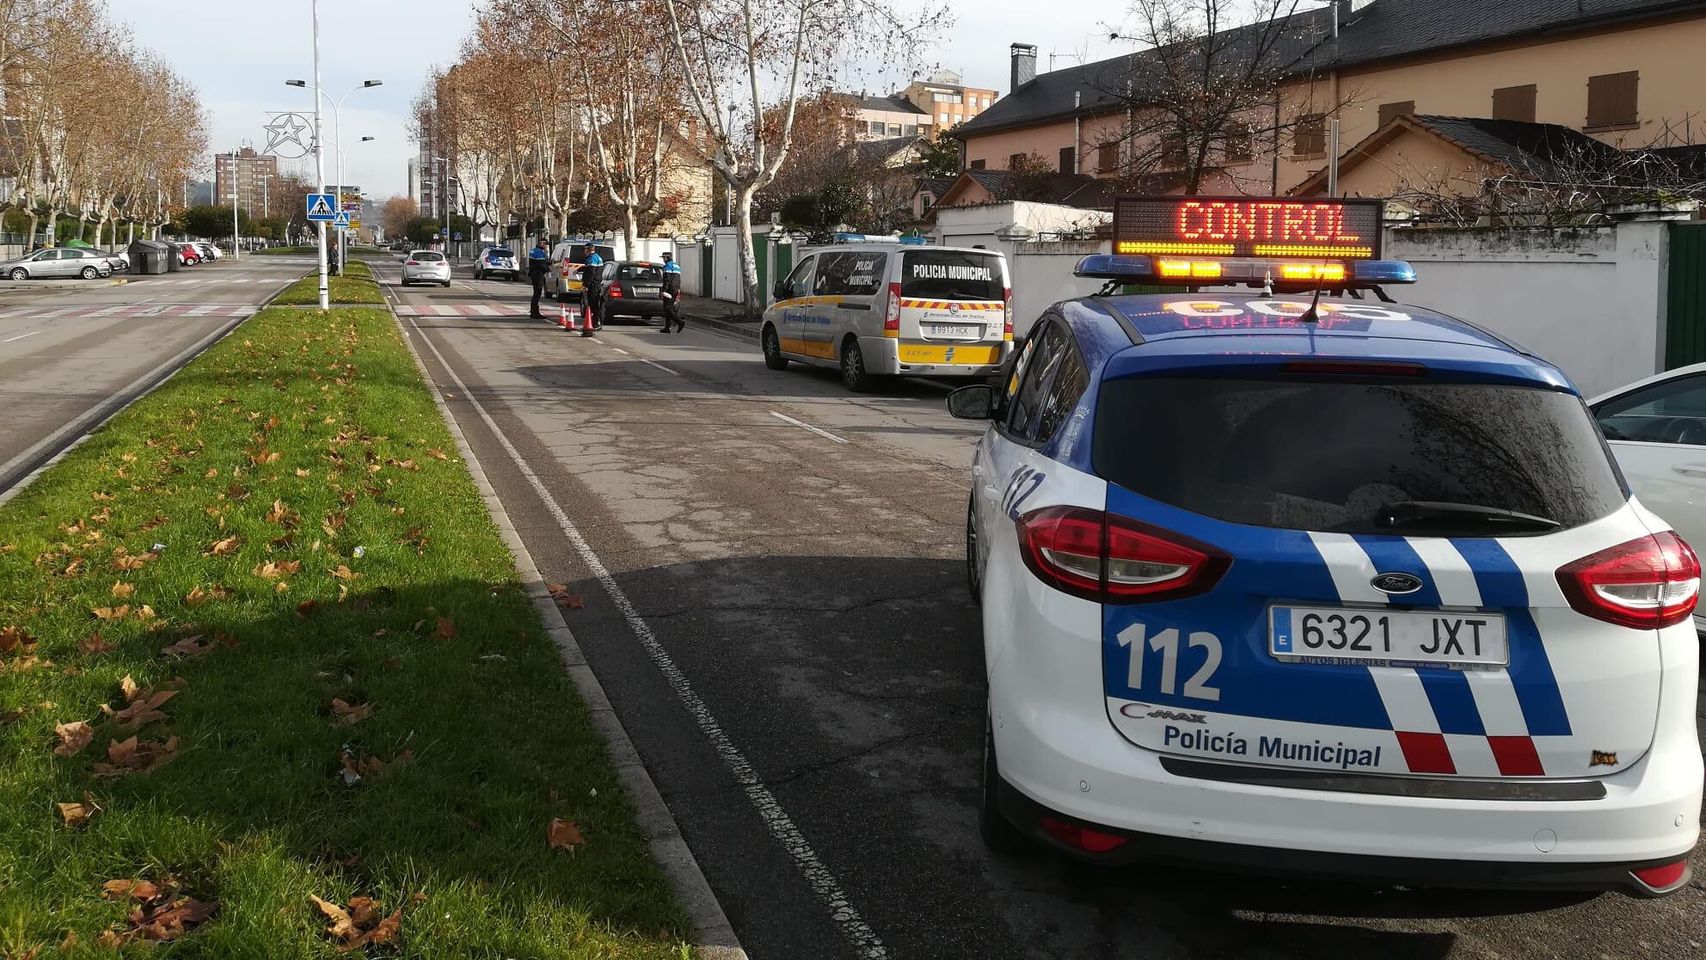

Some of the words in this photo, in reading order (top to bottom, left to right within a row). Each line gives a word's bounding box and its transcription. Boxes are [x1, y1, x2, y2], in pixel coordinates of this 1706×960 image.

[1179, 202, 1361, 242] CONTROL
[913, 264, 947, 279] POLICIA
[948, 265, 992, 281] MUNICIPAL
[1001, 464, 1047, 522] 112
[1383, 576, 1411, 589] Ford
[1279, 635, 1288, 645] E
[1302, 613, 1391, 652] 6321
[1420, 618, 1487, 656] JXT
[1115, 623, 1223, 702] 112
[1163, 724, 1248, 755] Policía
[1258, 735, 1382, 772] Municipal
